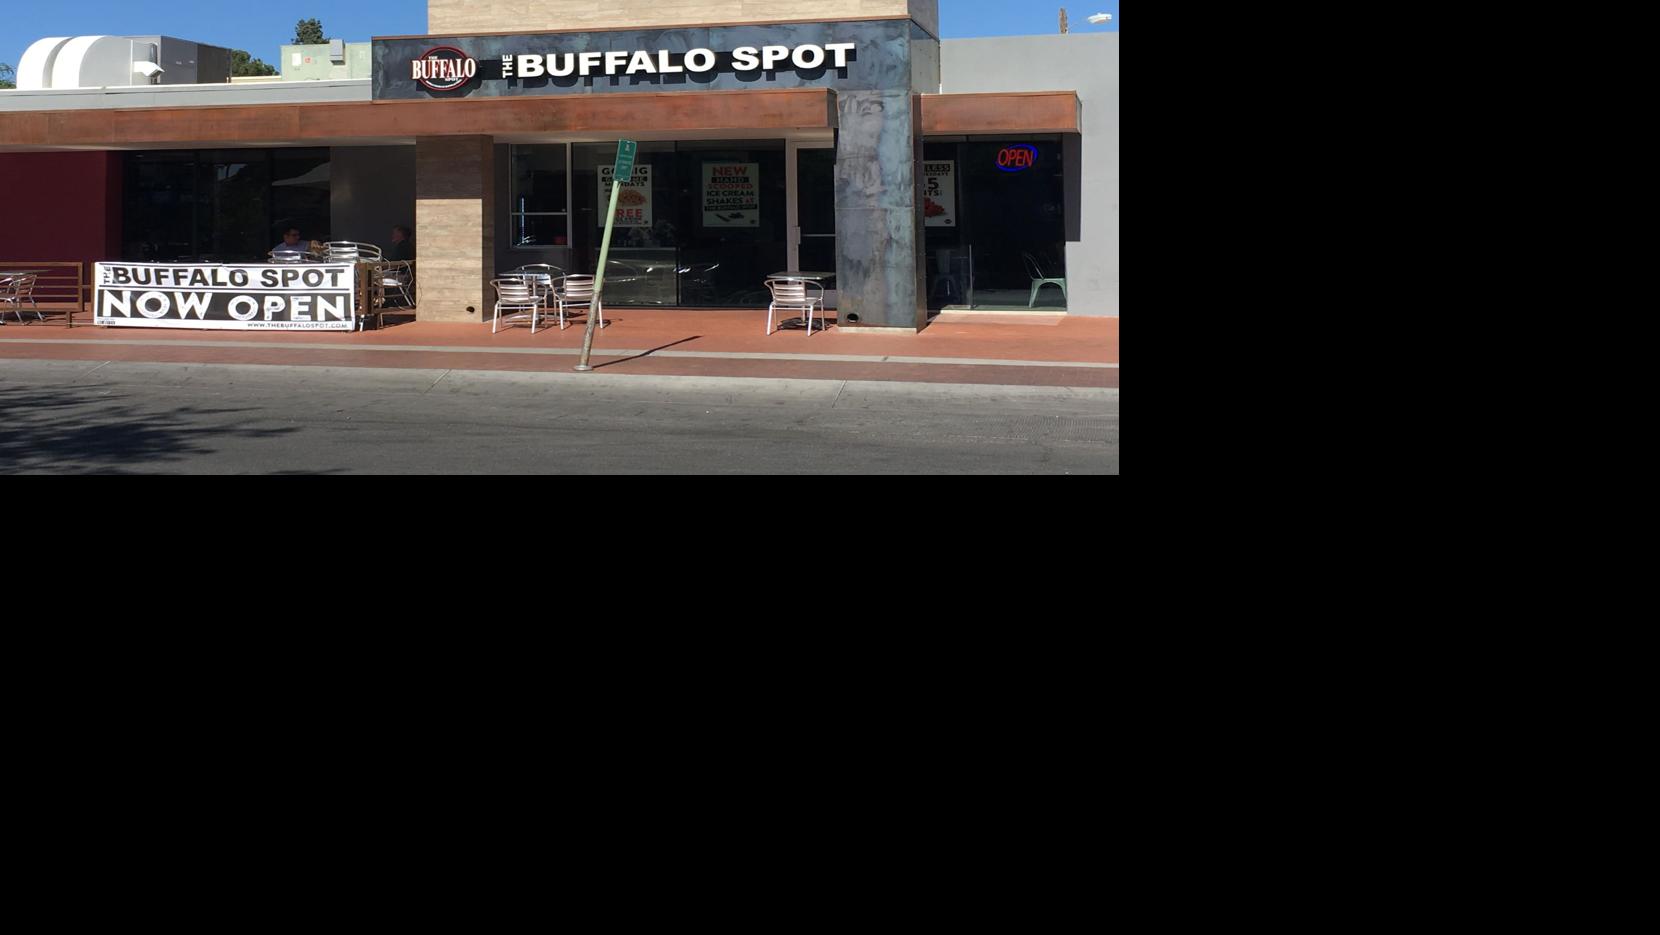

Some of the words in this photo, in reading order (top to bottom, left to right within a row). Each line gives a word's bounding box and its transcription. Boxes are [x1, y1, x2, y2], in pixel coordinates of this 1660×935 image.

[412, 58, 476, 80] BUFFALO
[502, 54, 513, 79] THE
[517, 47, 716, 78] BUFFALO
[731, 42, 856, 72] SPOT
[997, 149, 1034, 168] OPEN
[712, 166, 748, 177] NEW
[616, 209, 642, 217] REE
[103, 266, 111, 284] THE
[112, 266, 249, 287] BUFFALO
[260, 268, 345, 288] SPOT
[102, 290, 213, 320] NOW
[227, 295, 346, 322] OPEN
